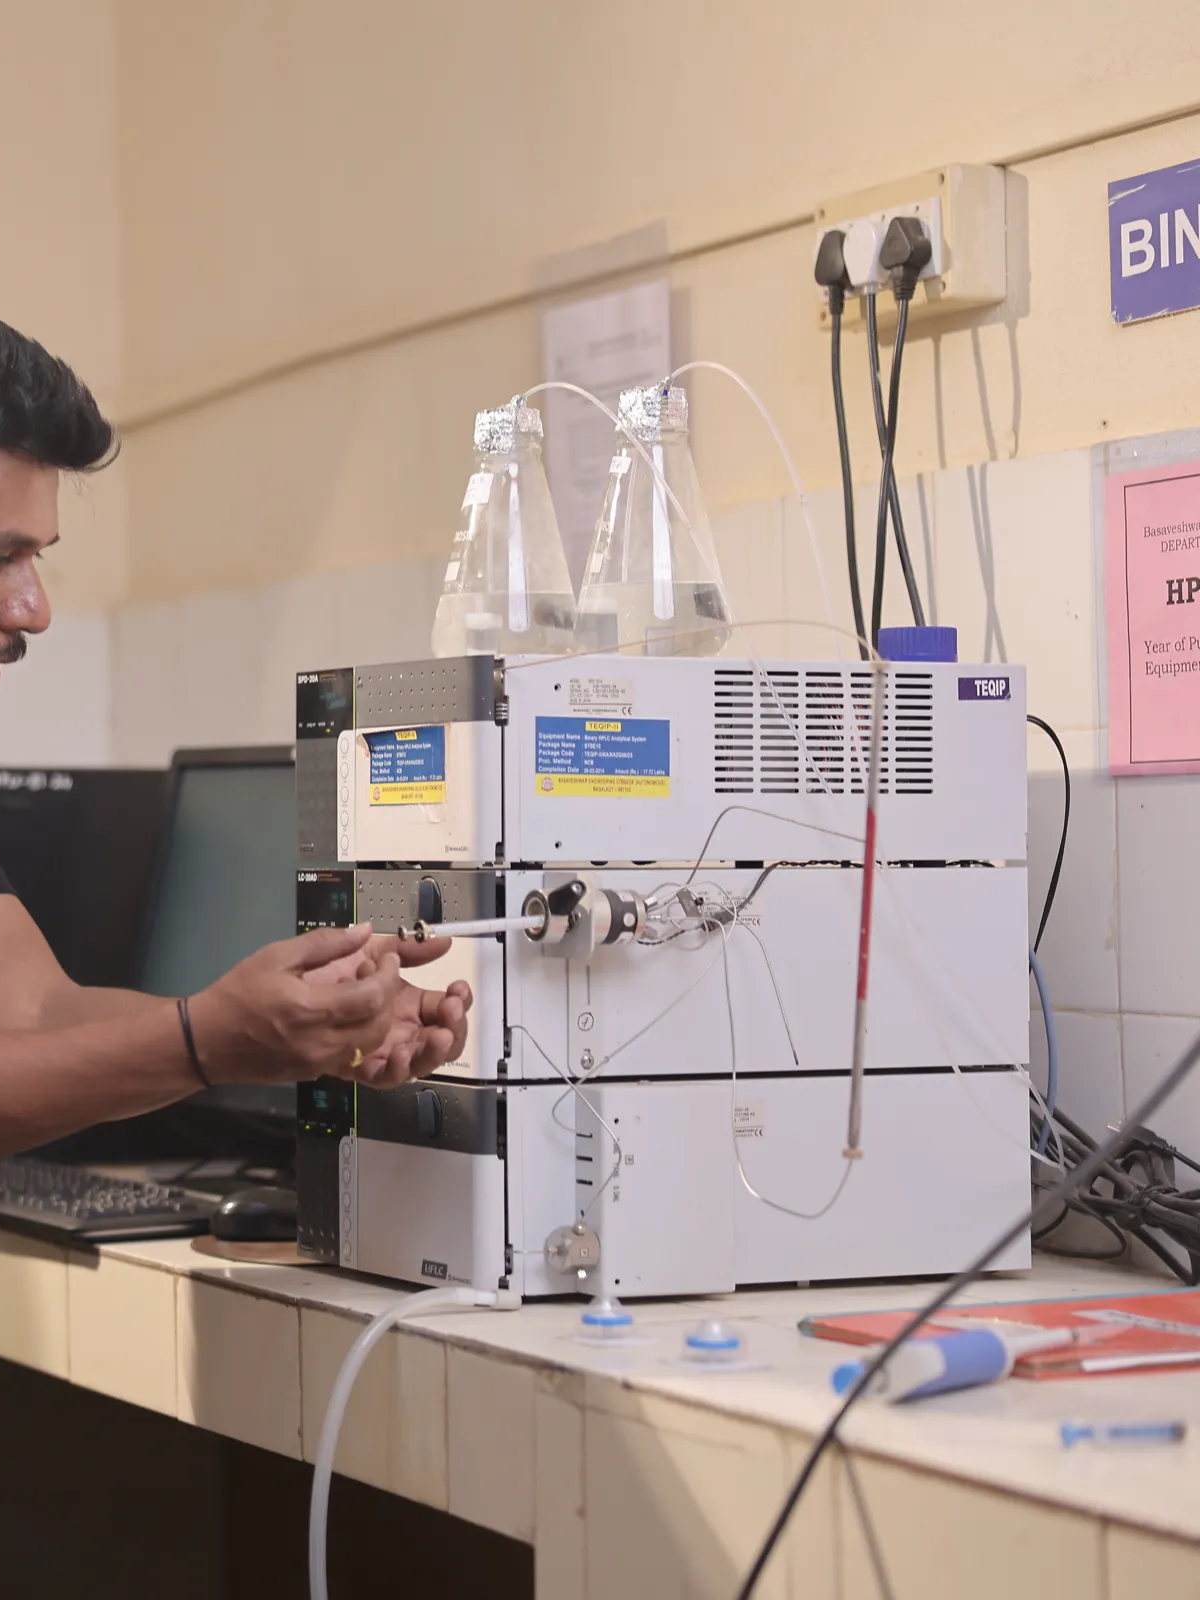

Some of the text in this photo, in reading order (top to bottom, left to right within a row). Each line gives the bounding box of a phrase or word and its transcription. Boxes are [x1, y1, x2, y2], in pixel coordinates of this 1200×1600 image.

[1120, 204, 1200, 278] BIN
[1143, 521, 1200, 538] Basaveshwa
[1161, 536, 1200, 553] DEPART
[1166, 577, 1200, 606] HP
[1144, 640, 1171, 654] Year
[1174, 636, 1186, 652] of
[1145, 659, 1200, 678] Equipme
[974, 679, 1006, 697] TEQIP
[589, 722, 619, 730] TEQIP-II
[538, 733, 566, 741] Equipment
[424, 1262, 445, 1277] UFLC
